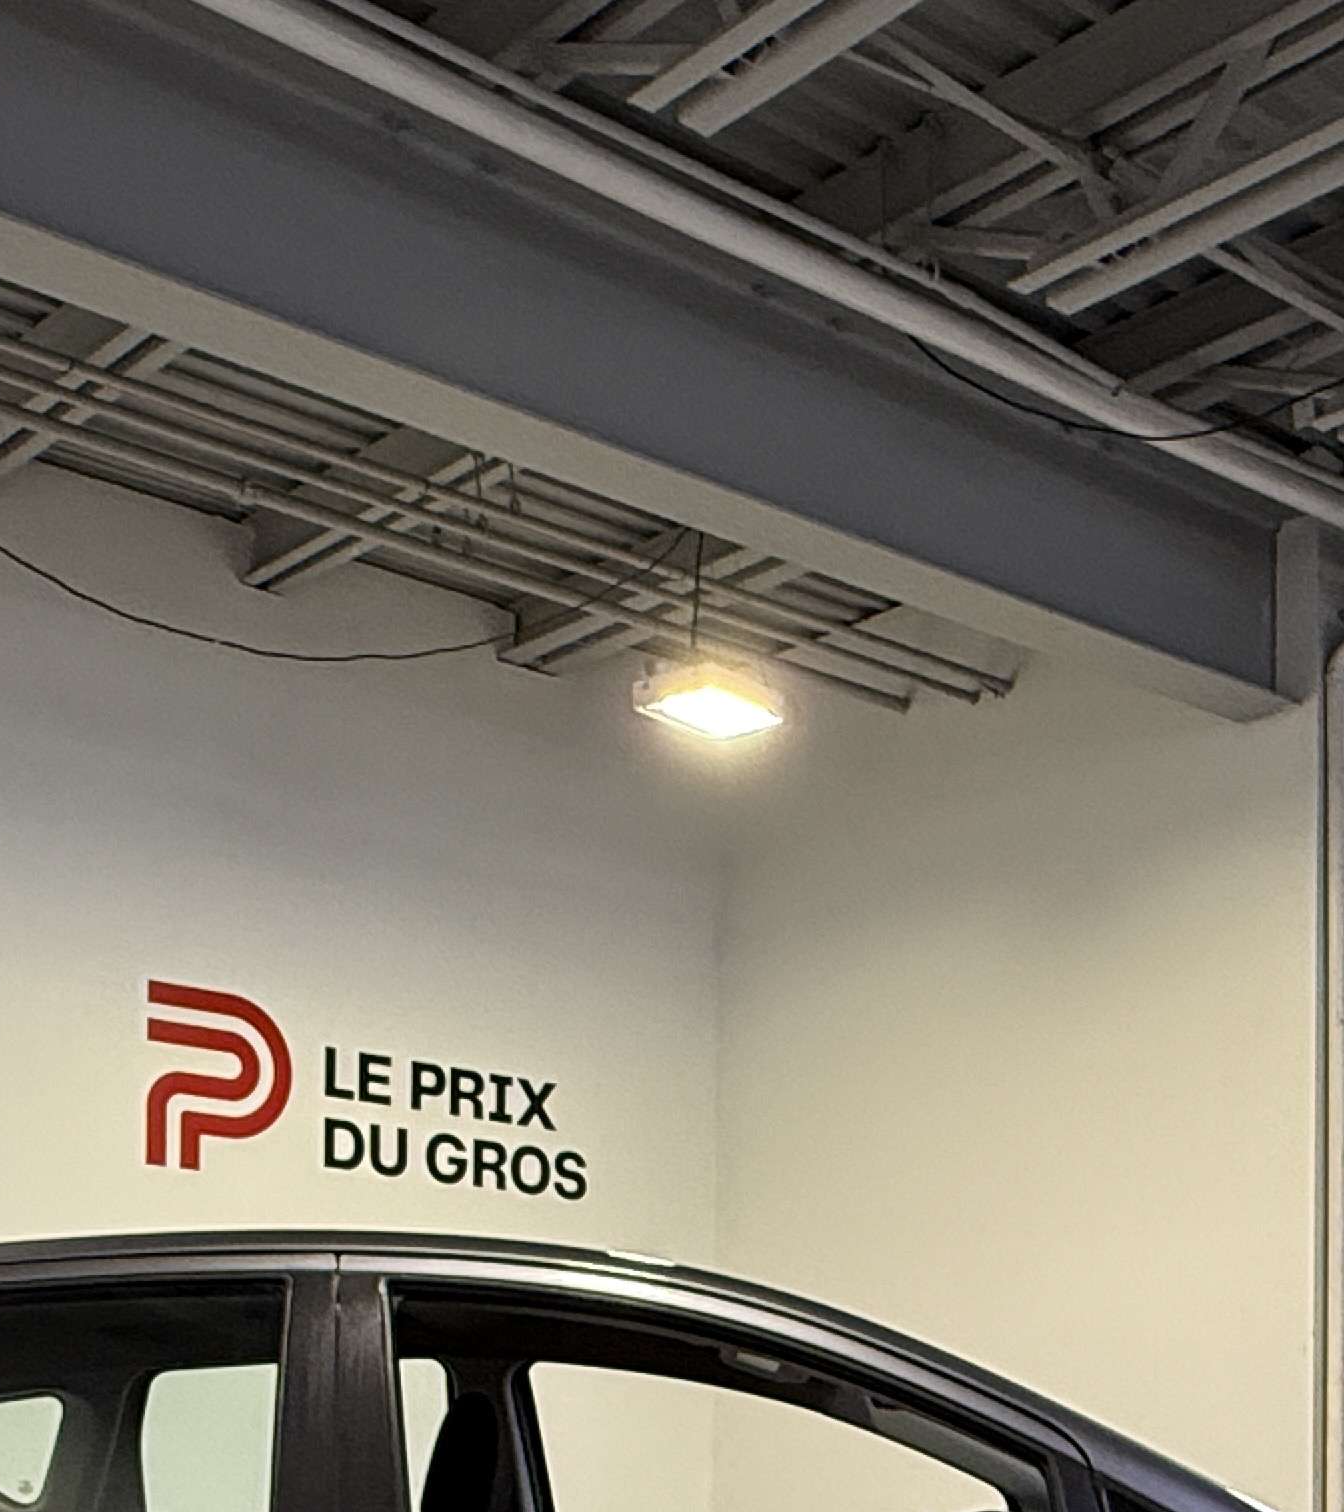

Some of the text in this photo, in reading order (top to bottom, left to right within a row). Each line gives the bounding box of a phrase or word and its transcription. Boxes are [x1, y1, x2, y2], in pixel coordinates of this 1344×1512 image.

[323, 1046, 557, 1131] LE PRIX
[323, 1117, 588, 1200] DU GROS
